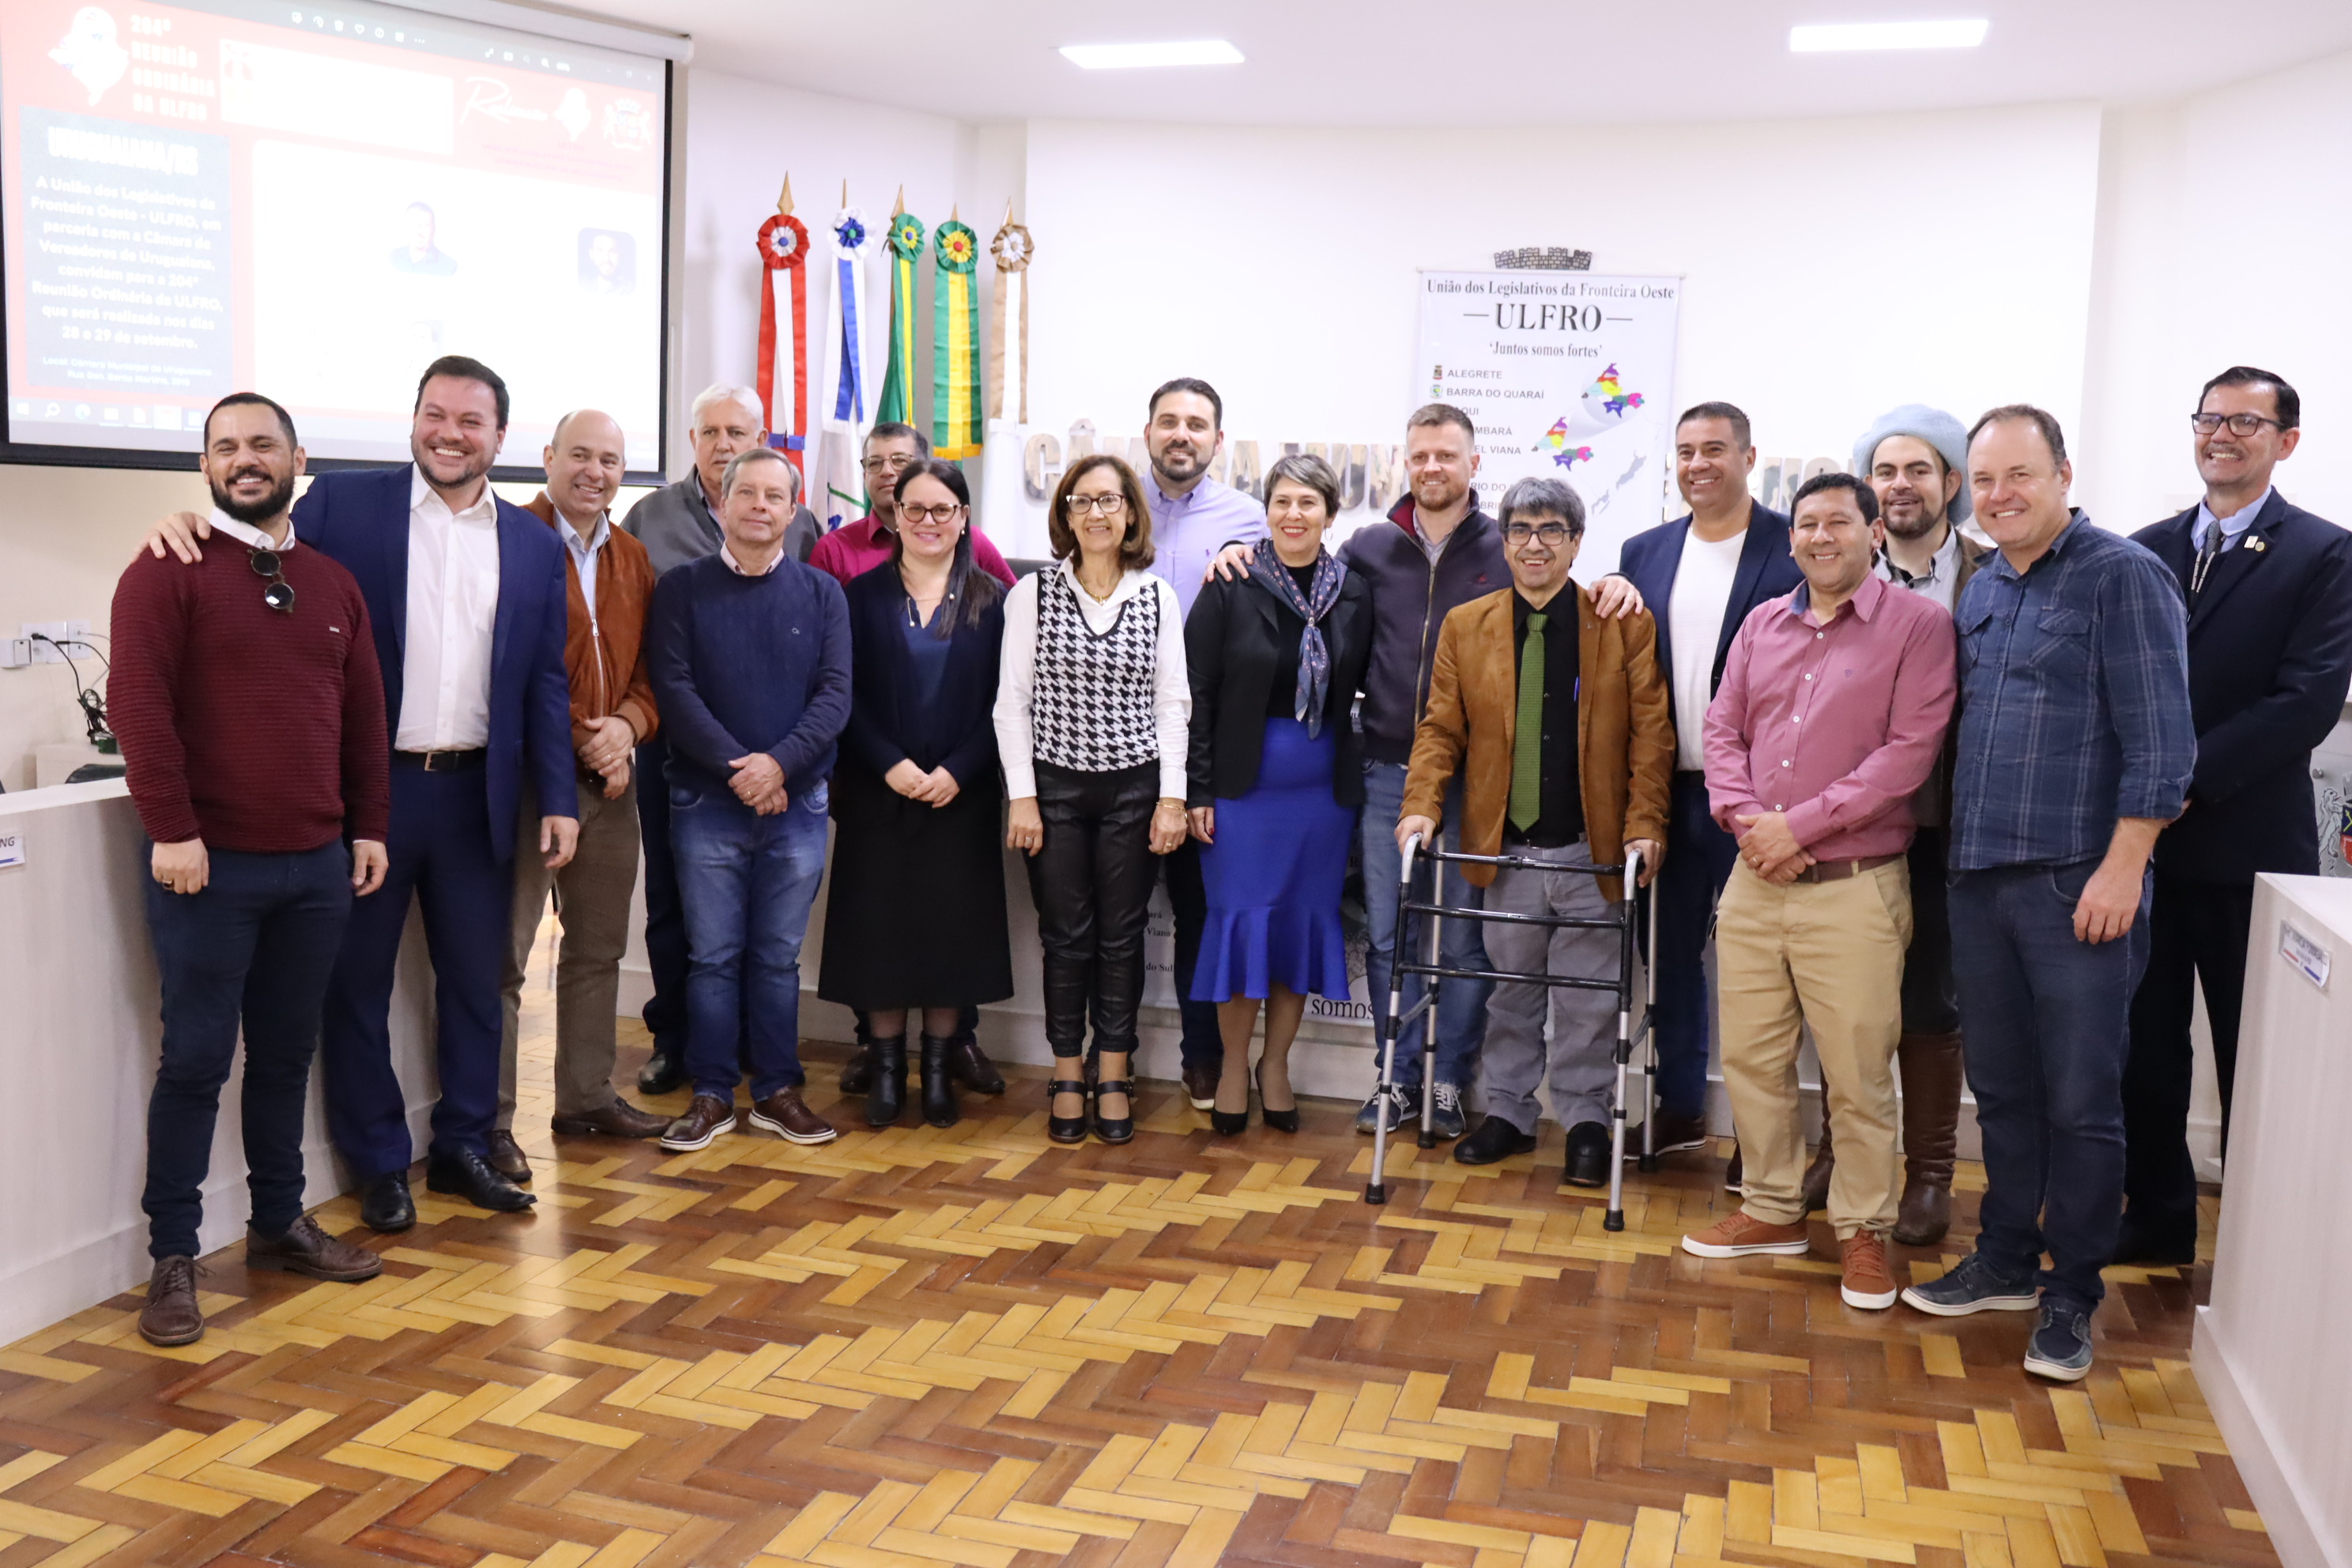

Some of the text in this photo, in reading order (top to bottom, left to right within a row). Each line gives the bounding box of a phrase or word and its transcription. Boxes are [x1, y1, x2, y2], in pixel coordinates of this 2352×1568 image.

[130, 40, 198, 70] REUNIÃO
[132, 66, 216, 98] ORDINÁRIA
[133, 92, 207, 122] DA ULFRO
[47, 126, 198, 176] URUGUAIANA/RS
[36, 175, 216, 210] A União dos Legislativos da
[31, 195, 94, 216] Fronteira
[96, 205, 138, 221] Oeste
[149, 210, 199, 230] ULFRO,
[202, 220, 221, 232] em
[43, 221, 211, 250] parceria com a Câmara de
[39, 239, 216, 272] Vereadores de Uruguaiana,
[58, 265, 123, 281] convidam
[126, 272, 155, 285] para
[157, 276, 166, 285] a
[32, 280, 224, 313] Reunião Ordinária da ULFRO,
[1427, 279, 1674, 299] União dos Legislativos da Fronteira Oeste
[42, 305, 215, 330] que será realizada nos dias
[1495, 303, 1602, 332] ULFRO
[62, 325, 198, 349] 28 e 29 de setembro.
[1532, 345, 1564, 356] somos
[67, 370, 85, 379] Rua
[70, 358, 106, 370] Câmara
[107, 361, 149, 373] Municipal
[1447, 370, 1502, 379] ALEGRETE
[1446, 387, 1544, 399] BARRA DO QUARAÍ
[1461, 407, 1479, 416] QUI
[1474, 425, 1513, 435] MBARÁ
[1474, 445, 1521, 455] EL VIANA
[1471, 481, 1506, 492] RIO DO
[1147, 928, 1170, 937] Viana
[1146, 963, 1173, 972] do Sul
